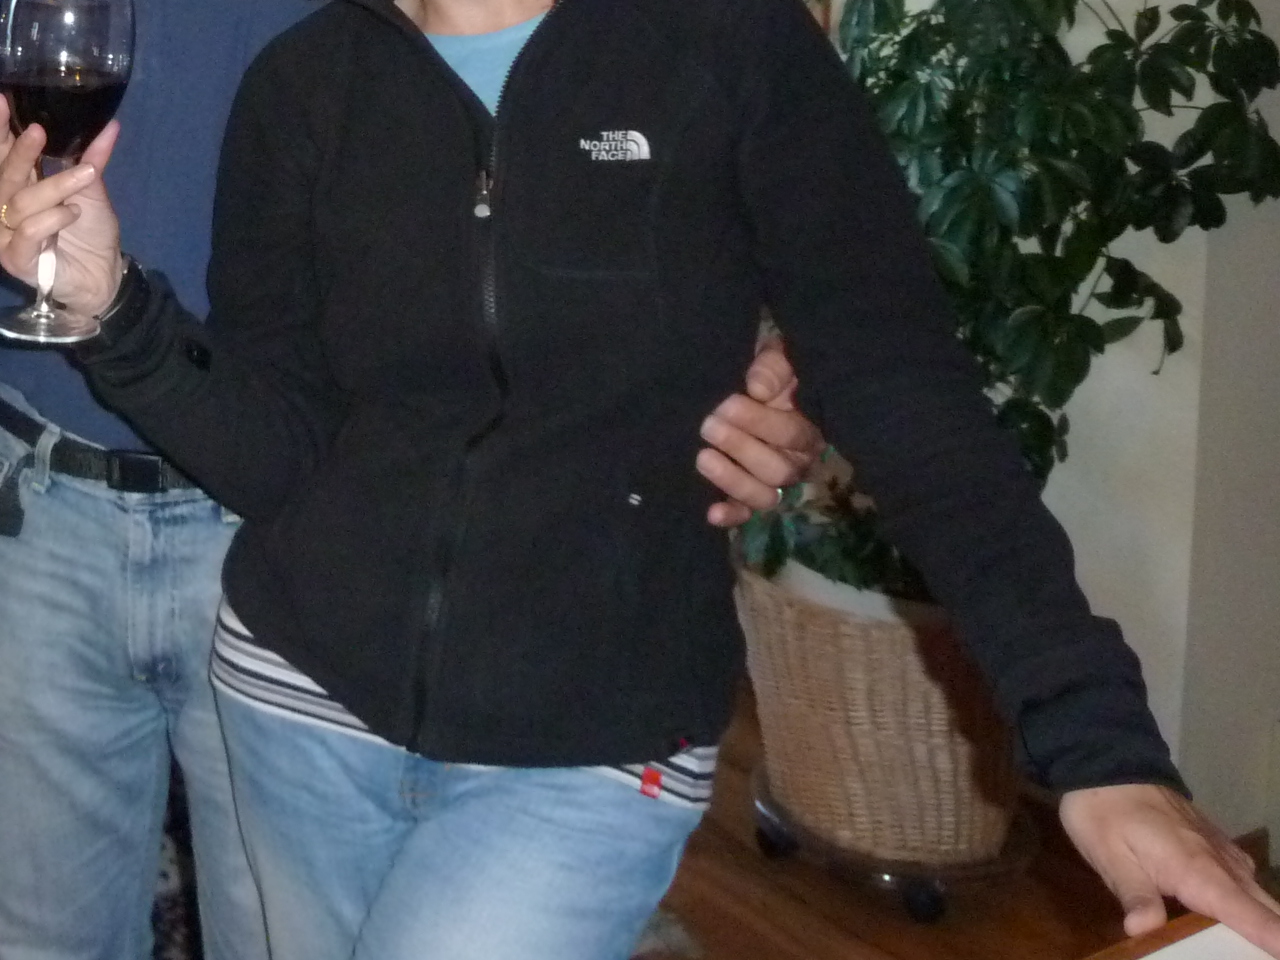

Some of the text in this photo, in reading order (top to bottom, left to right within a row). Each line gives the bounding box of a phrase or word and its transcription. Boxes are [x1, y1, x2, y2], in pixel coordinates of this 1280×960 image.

[601, 131, 627, 141] THE
[580, 139, 627, 151] NORTH
[591, 151, 627, 161] FACE
